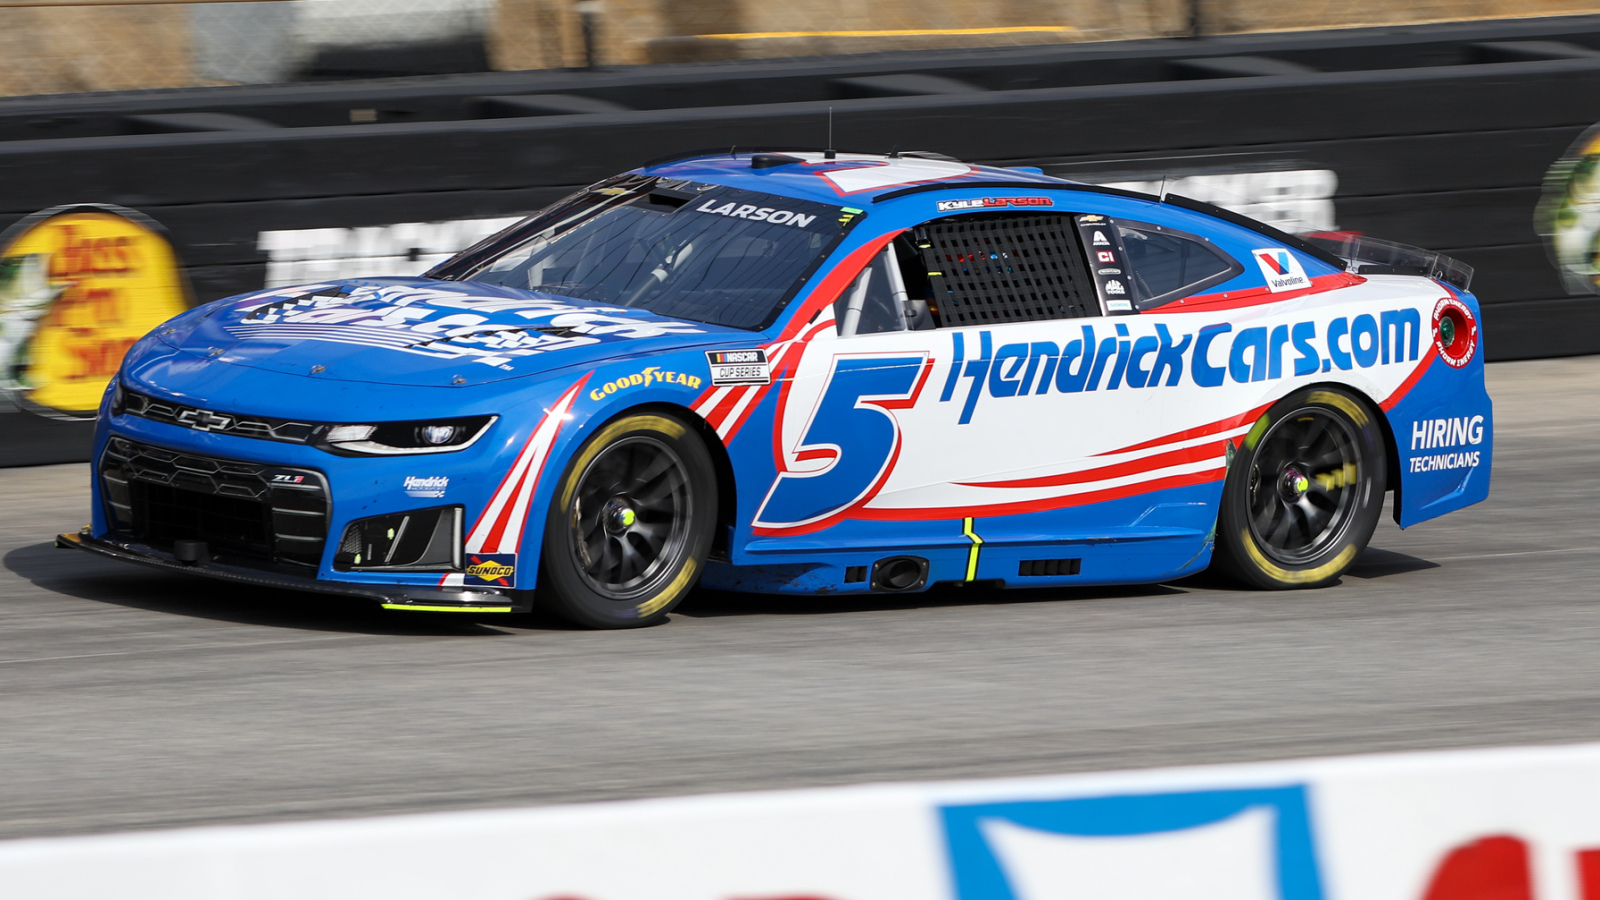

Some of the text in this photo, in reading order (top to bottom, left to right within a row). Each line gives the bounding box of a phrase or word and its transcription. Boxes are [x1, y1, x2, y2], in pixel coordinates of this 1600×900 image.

[696, 199, 816, 228] LARSON
[1271, 276, 1304, 288] Valvoline
[727, 351, 759, 362] NASCAR
[939, 307, 1420, 424] HendrickCars.com
[720, 366, 761, 378] CUP SERIES
[590, 369, 702, 401] GOODYEAR
[754, 352, 932, 531] 5
[1411, 414, 1484, 450] HIRING
[1409, 451, 1481, 473] TECHNICIANS
[402, 476, 450, 490] Hendrick
[468, 566, 512, 576] SUNOCO
